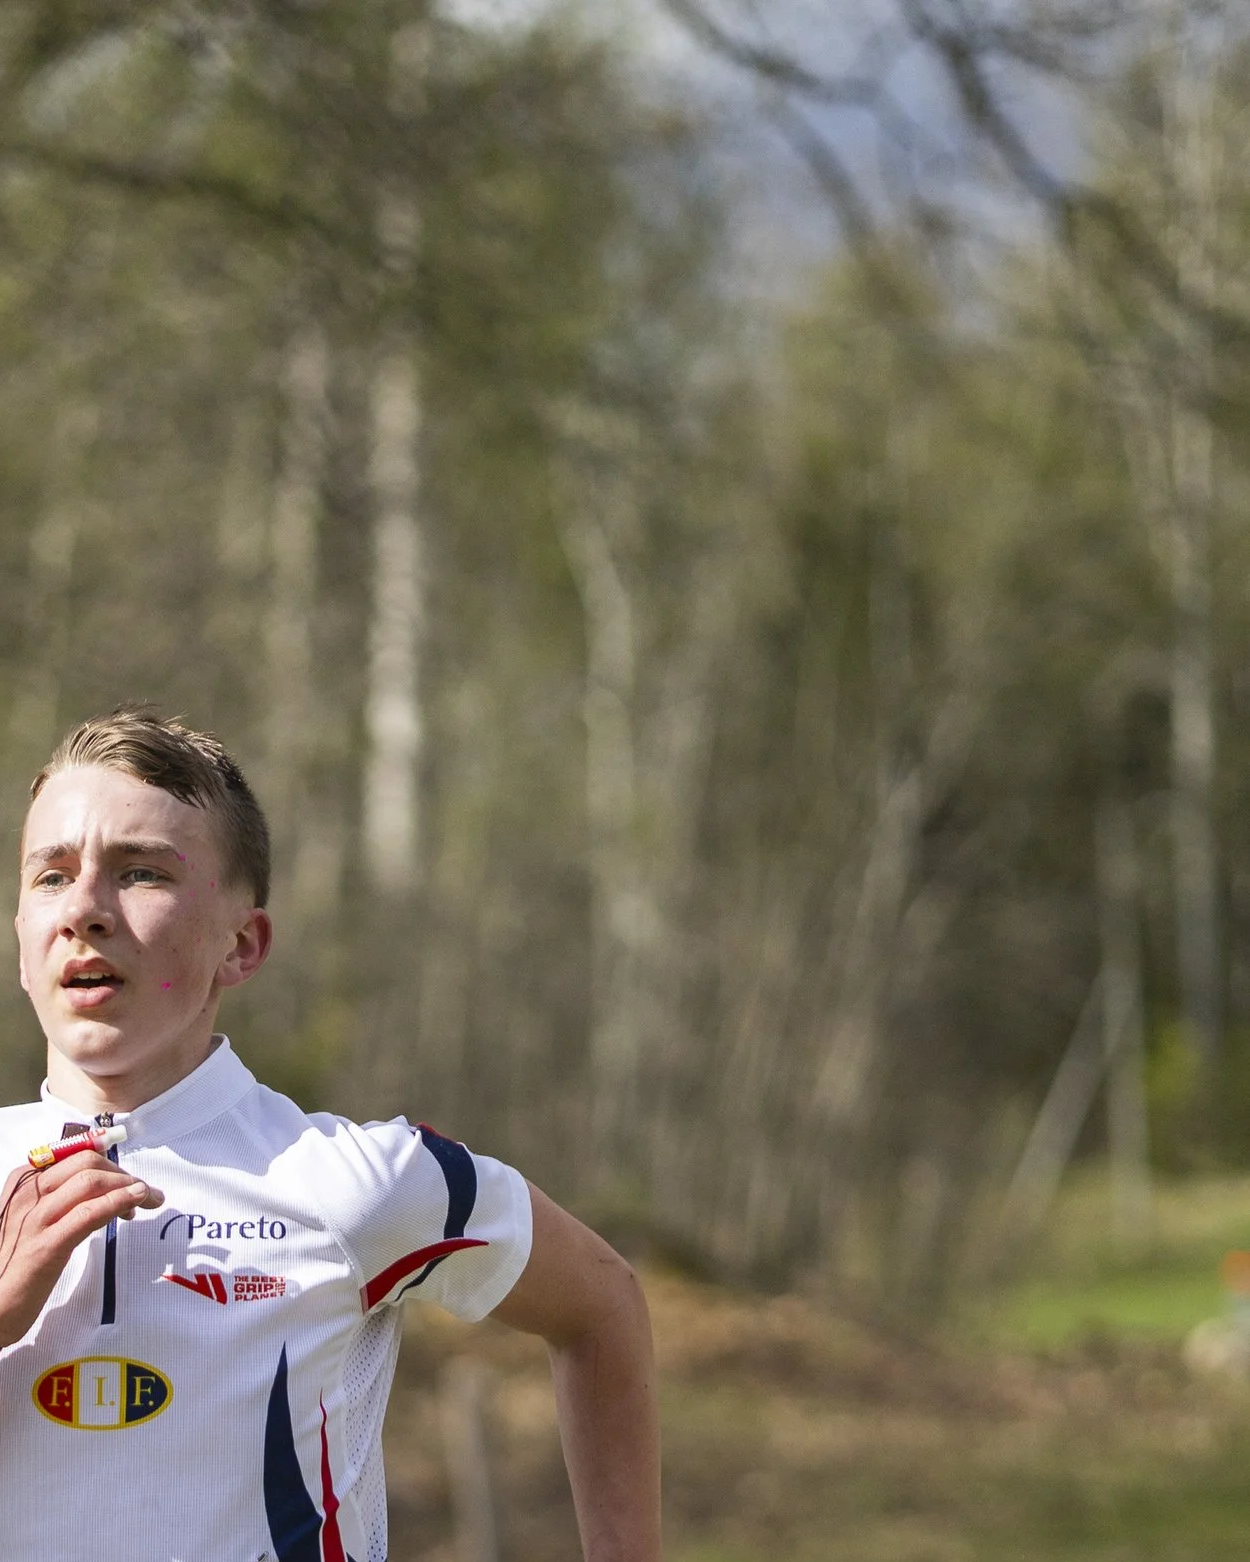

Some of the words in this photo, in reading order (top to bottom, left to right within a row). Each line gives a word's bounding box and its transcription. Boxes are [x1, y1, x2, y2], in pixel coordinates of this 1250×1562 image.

[187, 1214, 287, 1240] Pareto
[234, 1283, 274, 1293] GRIP
[235, 1291, 286, 1301] PLANET
